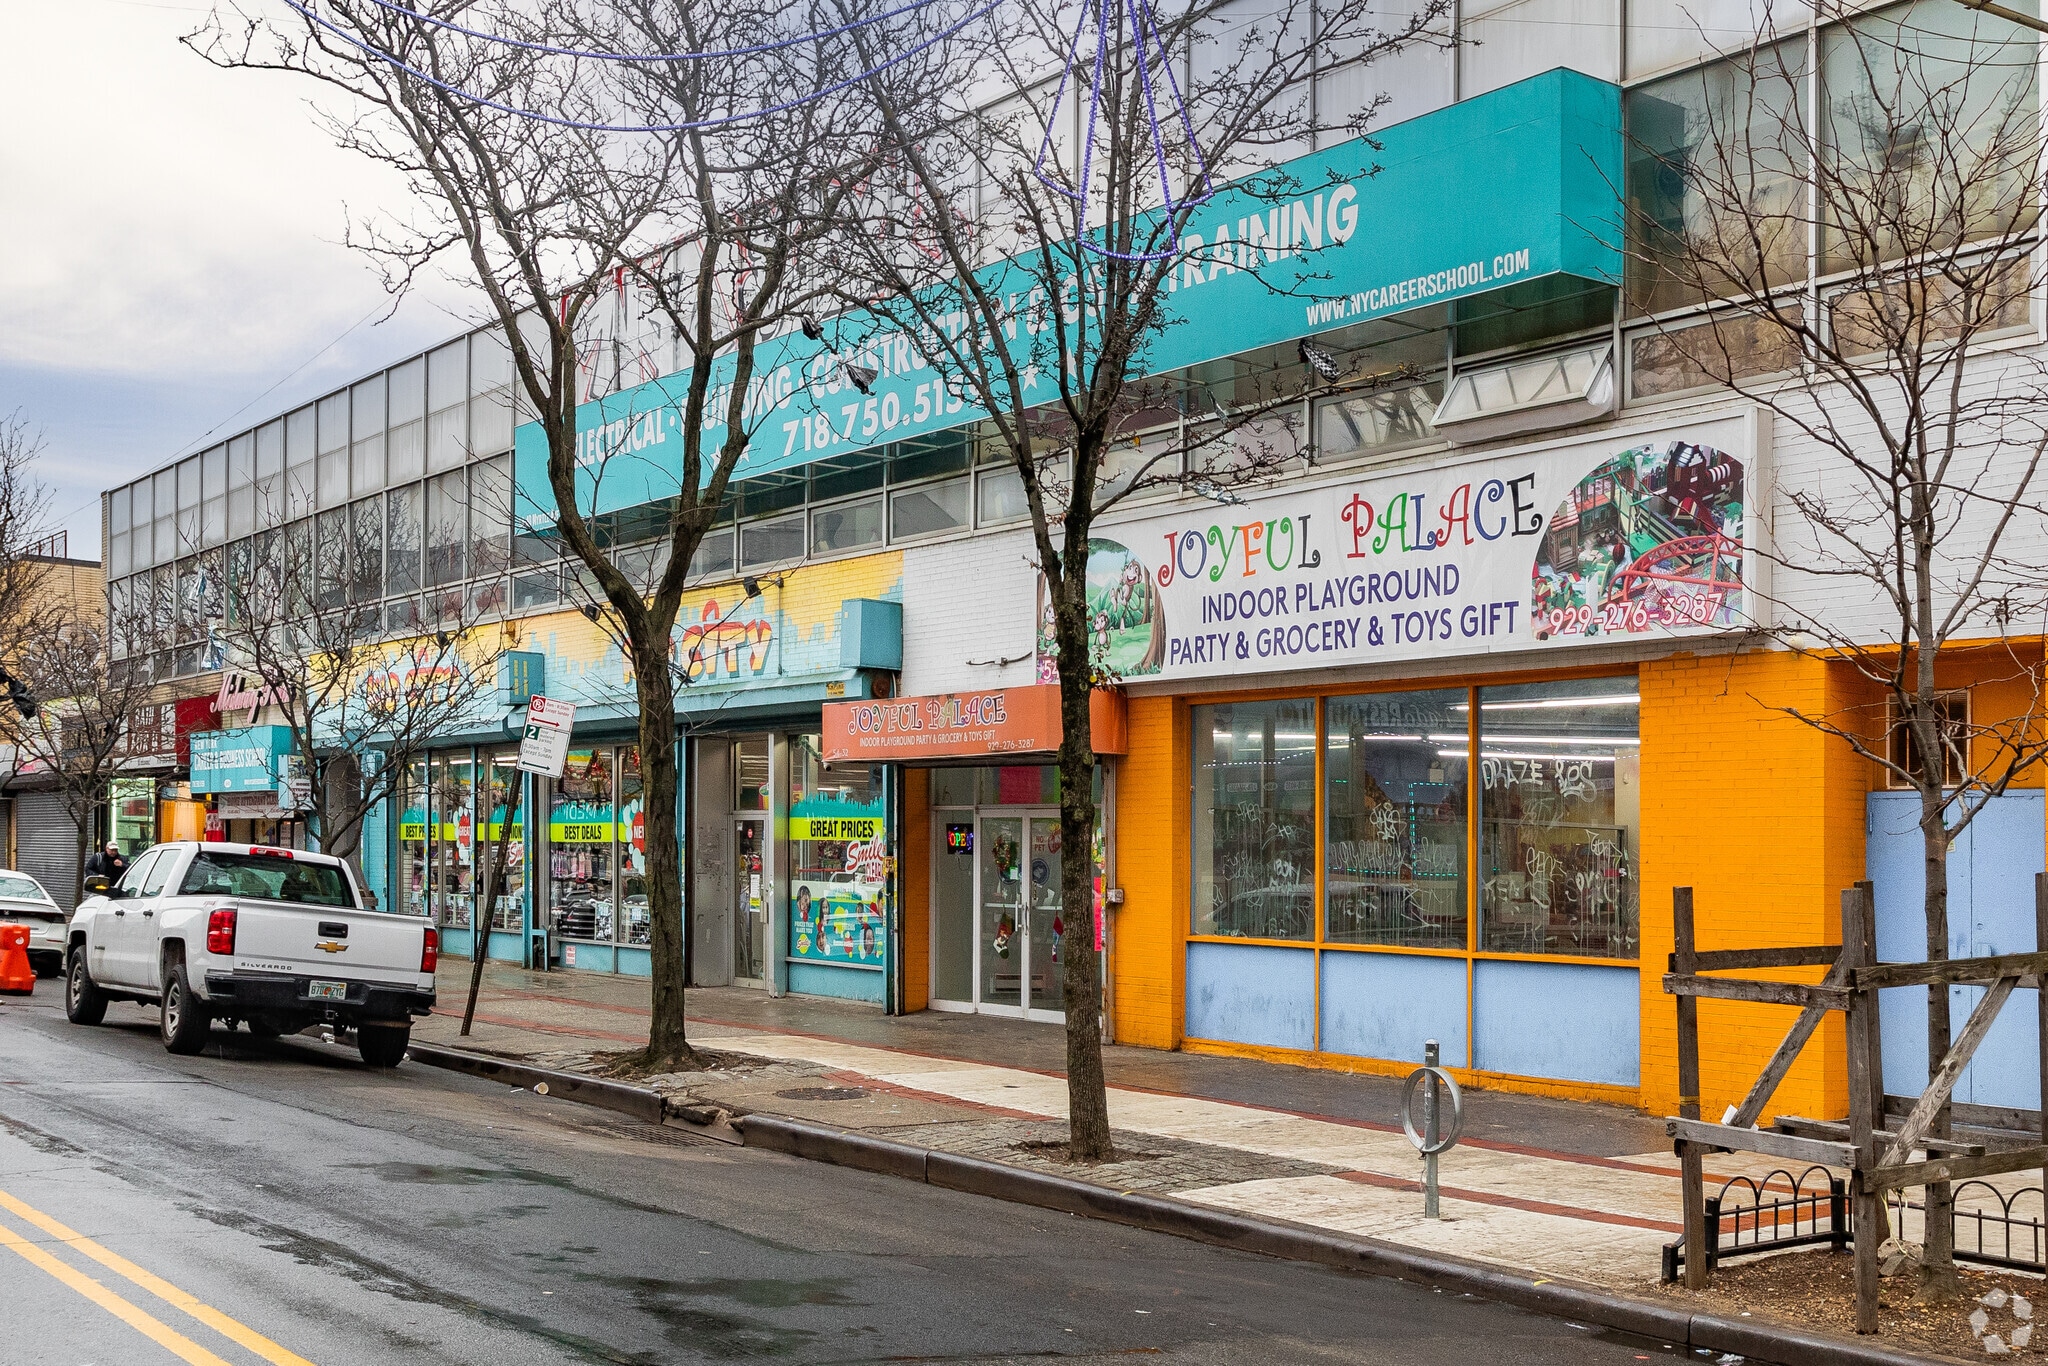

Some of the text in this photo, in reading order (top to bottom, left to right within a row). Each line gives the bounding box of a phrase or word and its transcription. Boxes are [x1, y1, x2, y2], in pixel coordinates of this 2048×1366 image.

[1306, 248, 1530, 327] WWW.NYCAREERSCHOOL.COM
[1158, 472, 1543, 587] JOYFUL PALACE
[1203, 564, 1459, 624] INDOOR PLAYGROUND
[1550, 592, 1723, 635] 929-276-3287
[1170, 601, 1519, 665] PARTY & GROCERY & TOYS GIFT
[528, 726, 536, 738] 2
[848, 694, 1007, 735] JOYFUL PALACE
[860, 737, 880, 747] INDOOR
[881, 735, 915, 747] PLAYGROUND
[916, 734, 932, 744] PARTY
[938, 733, 963, 743] GROCERY
[968, 731, 982, 741] TOYS
[983, 730, 995, 740] GIFT
[564, 825, 602, 840] BEST DEALS
[810, 820, 874, 838] GREAT PRICES
[240, 961, 292, 971] SILVERADO
